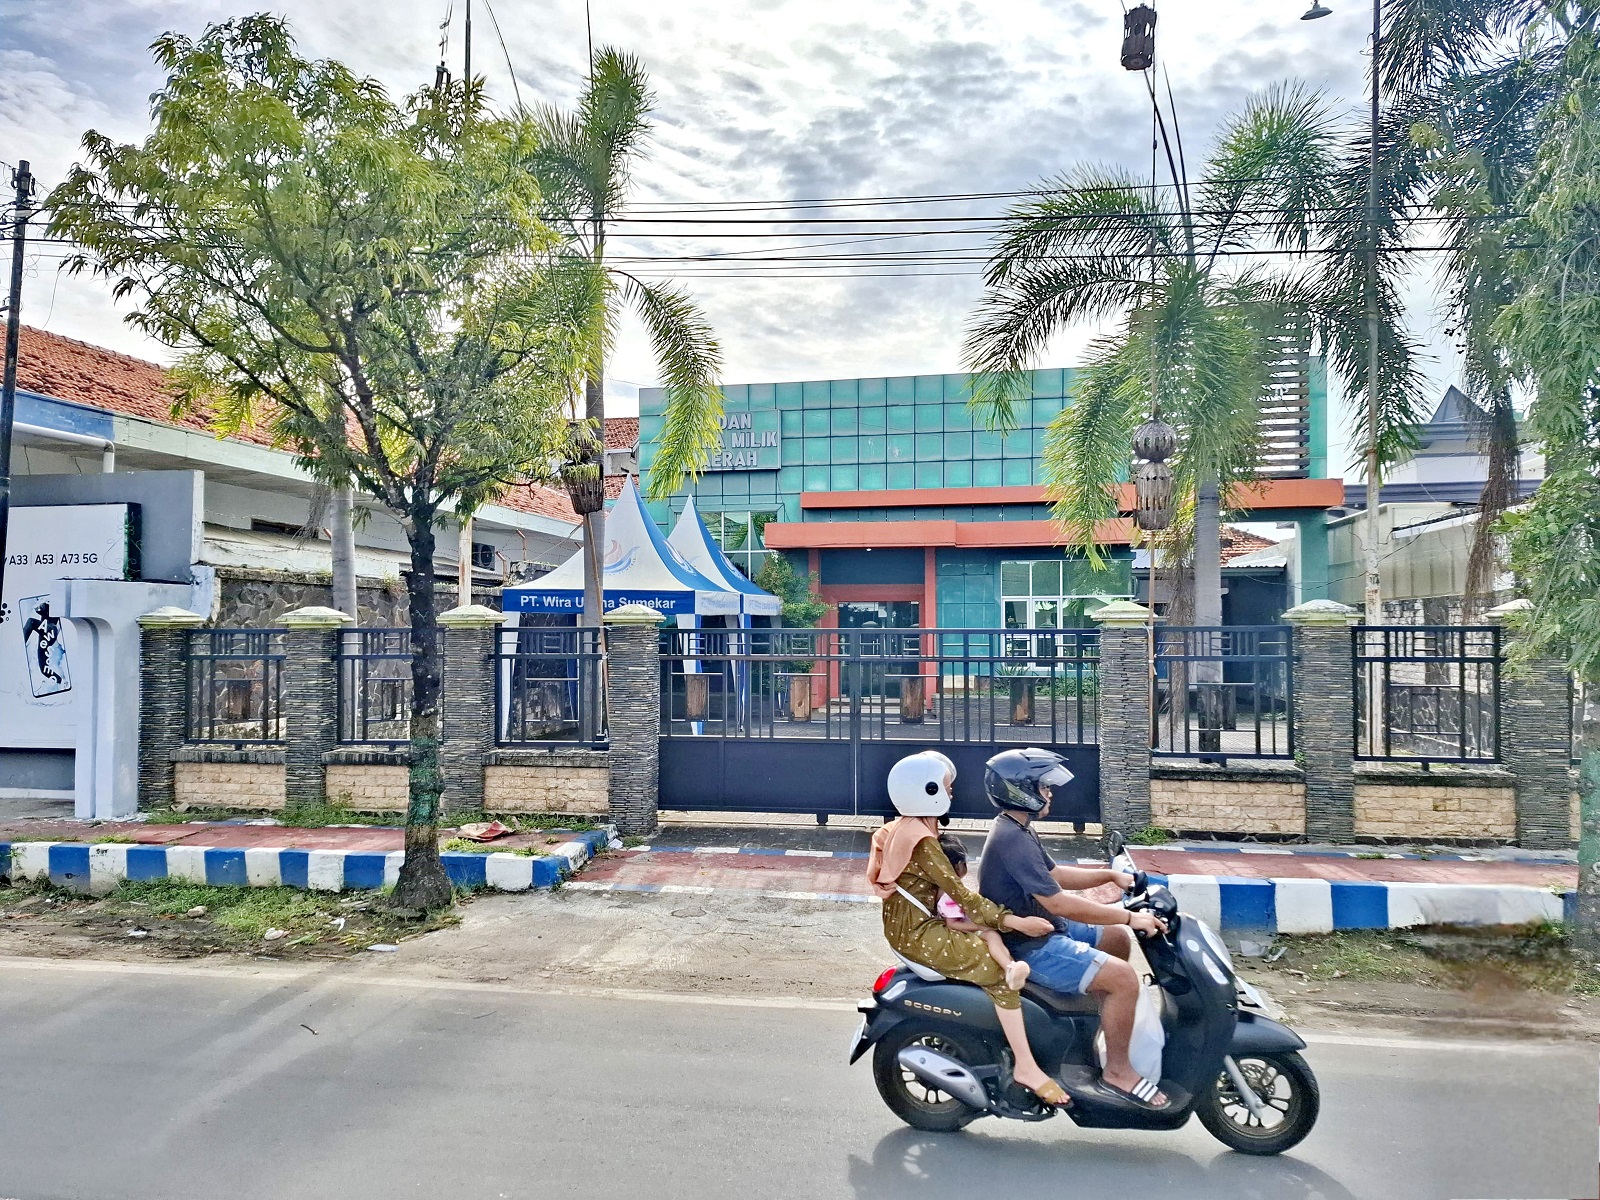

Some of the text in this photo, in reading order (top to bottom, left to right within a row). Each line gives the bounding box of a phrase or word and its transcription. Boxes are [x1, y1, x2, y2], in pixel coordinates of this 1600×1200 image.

[716, 414, 752, 430] DAN
[731, 431, 778, 448] MILIK
[700, 450, 758, 467] AERAH
[9, 554, 28, 566] A33
[34, 553, 54, 565] A53
[60, 553, 80, 565] A73
[82, 552, 98, 564] 5G
[520, 595, 540, 607] PT.
[542, 595, 572, 608] Wira
[904, 999, 962, 1017] SCOOPY
